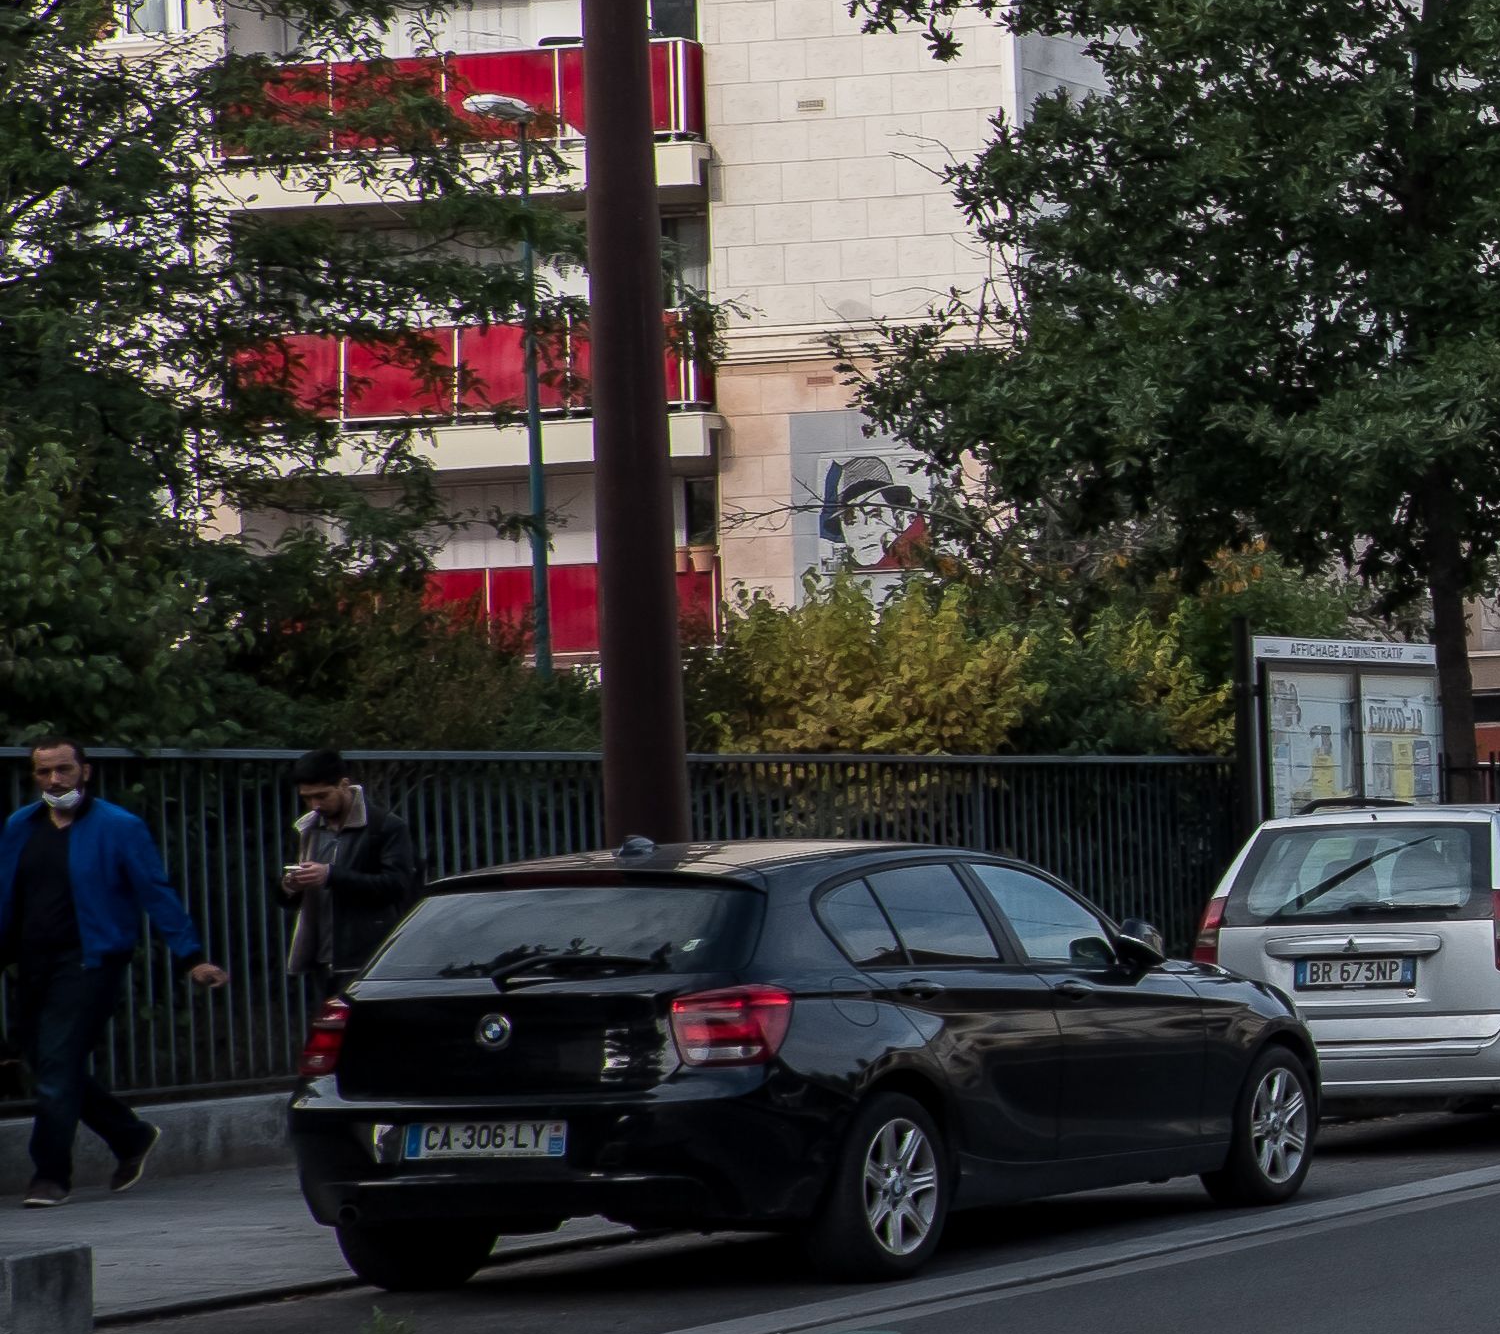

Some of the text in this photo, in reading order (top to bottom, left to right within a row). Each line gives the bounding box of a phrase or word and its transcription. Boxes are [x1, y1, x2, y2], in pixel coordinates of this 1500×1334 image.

[1290, 642, 1340, 658] AFFICHAGE
[1341, 645, 1405, 660] ADMINISTRATIF
[1310, 960, 1400, 983] BR 673NP
[424, 1123, 547, 1151] CA-306-LY
